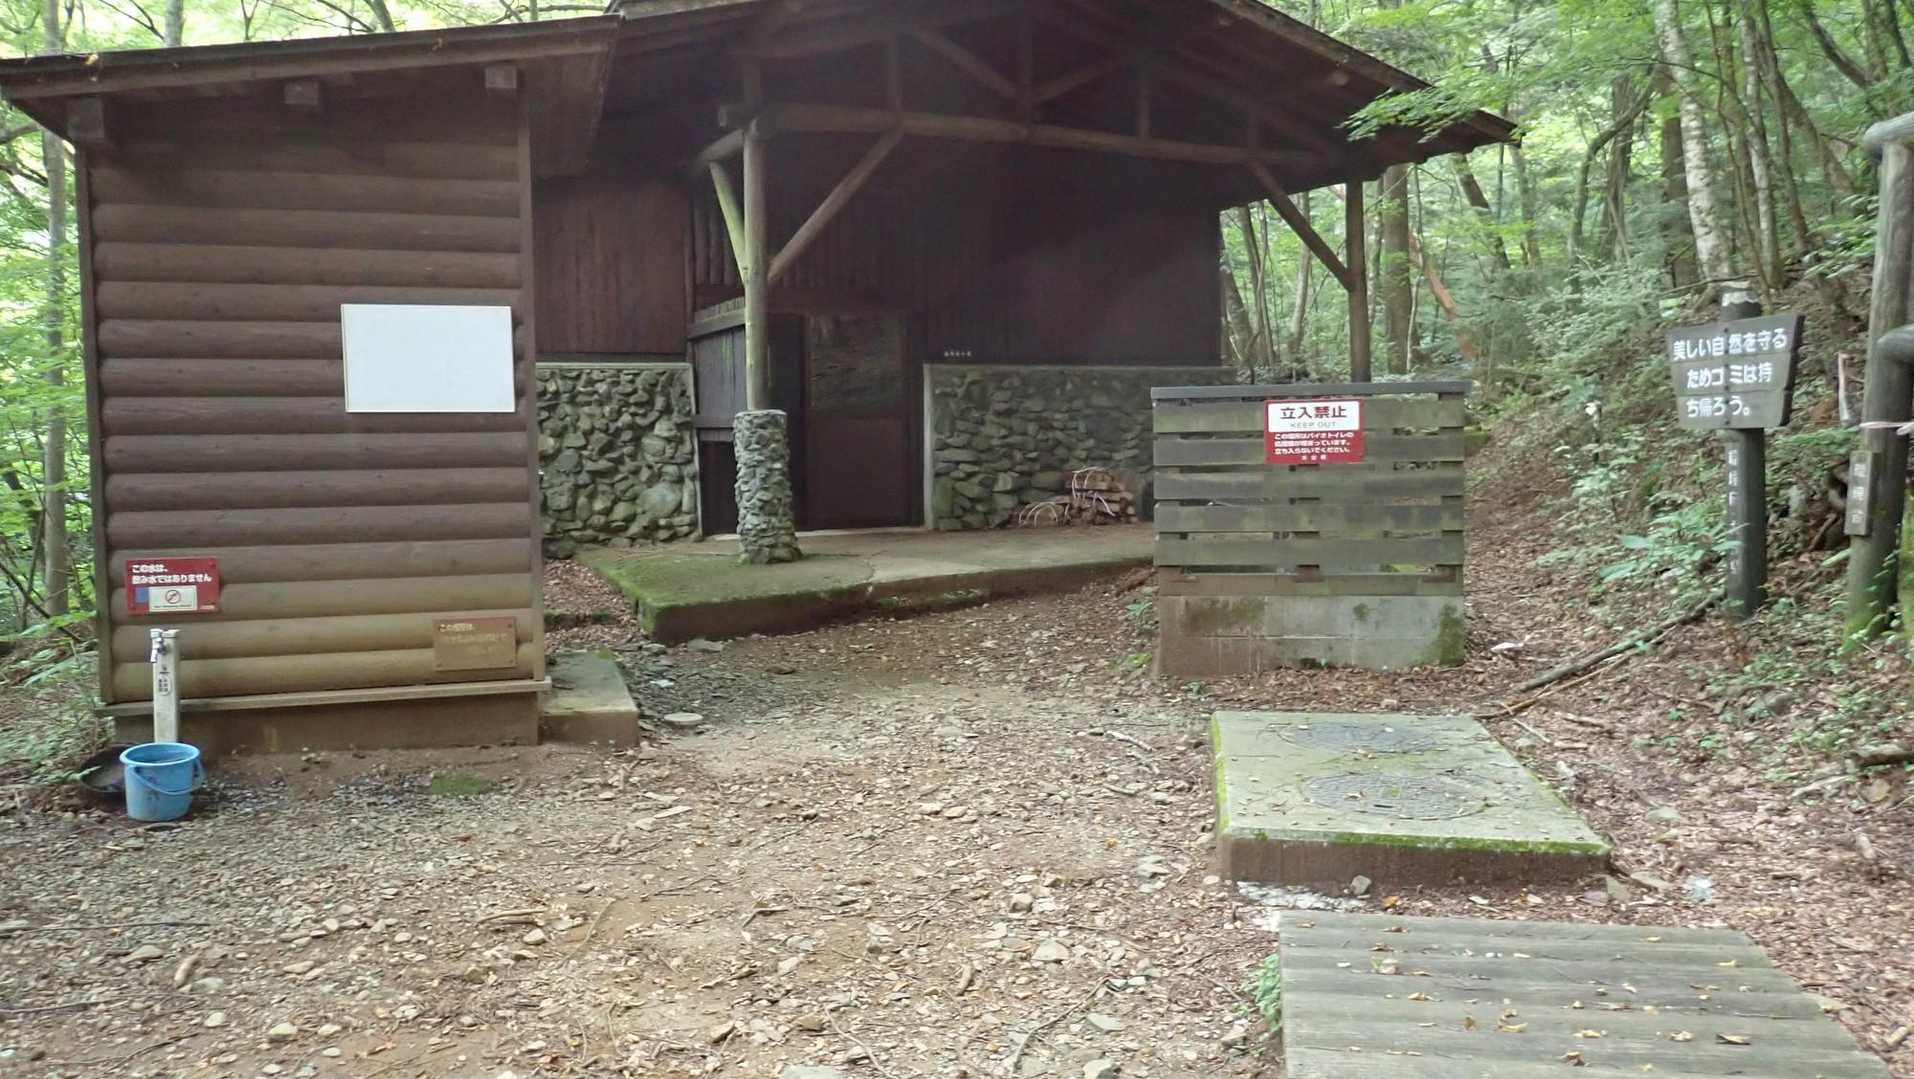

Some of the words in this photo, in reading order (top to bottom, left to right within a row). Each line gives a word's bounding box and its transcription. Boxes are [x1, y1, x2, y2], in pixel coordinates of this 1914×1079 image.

[1673, 328, 1787, 360] 美しい自然を守る
[1687, 362, 1773, 389] ためゴミは持
[1280, 405, 1347, 420] 立入禁止
[1686, 395, 1751, 417] ち帰ろう。
